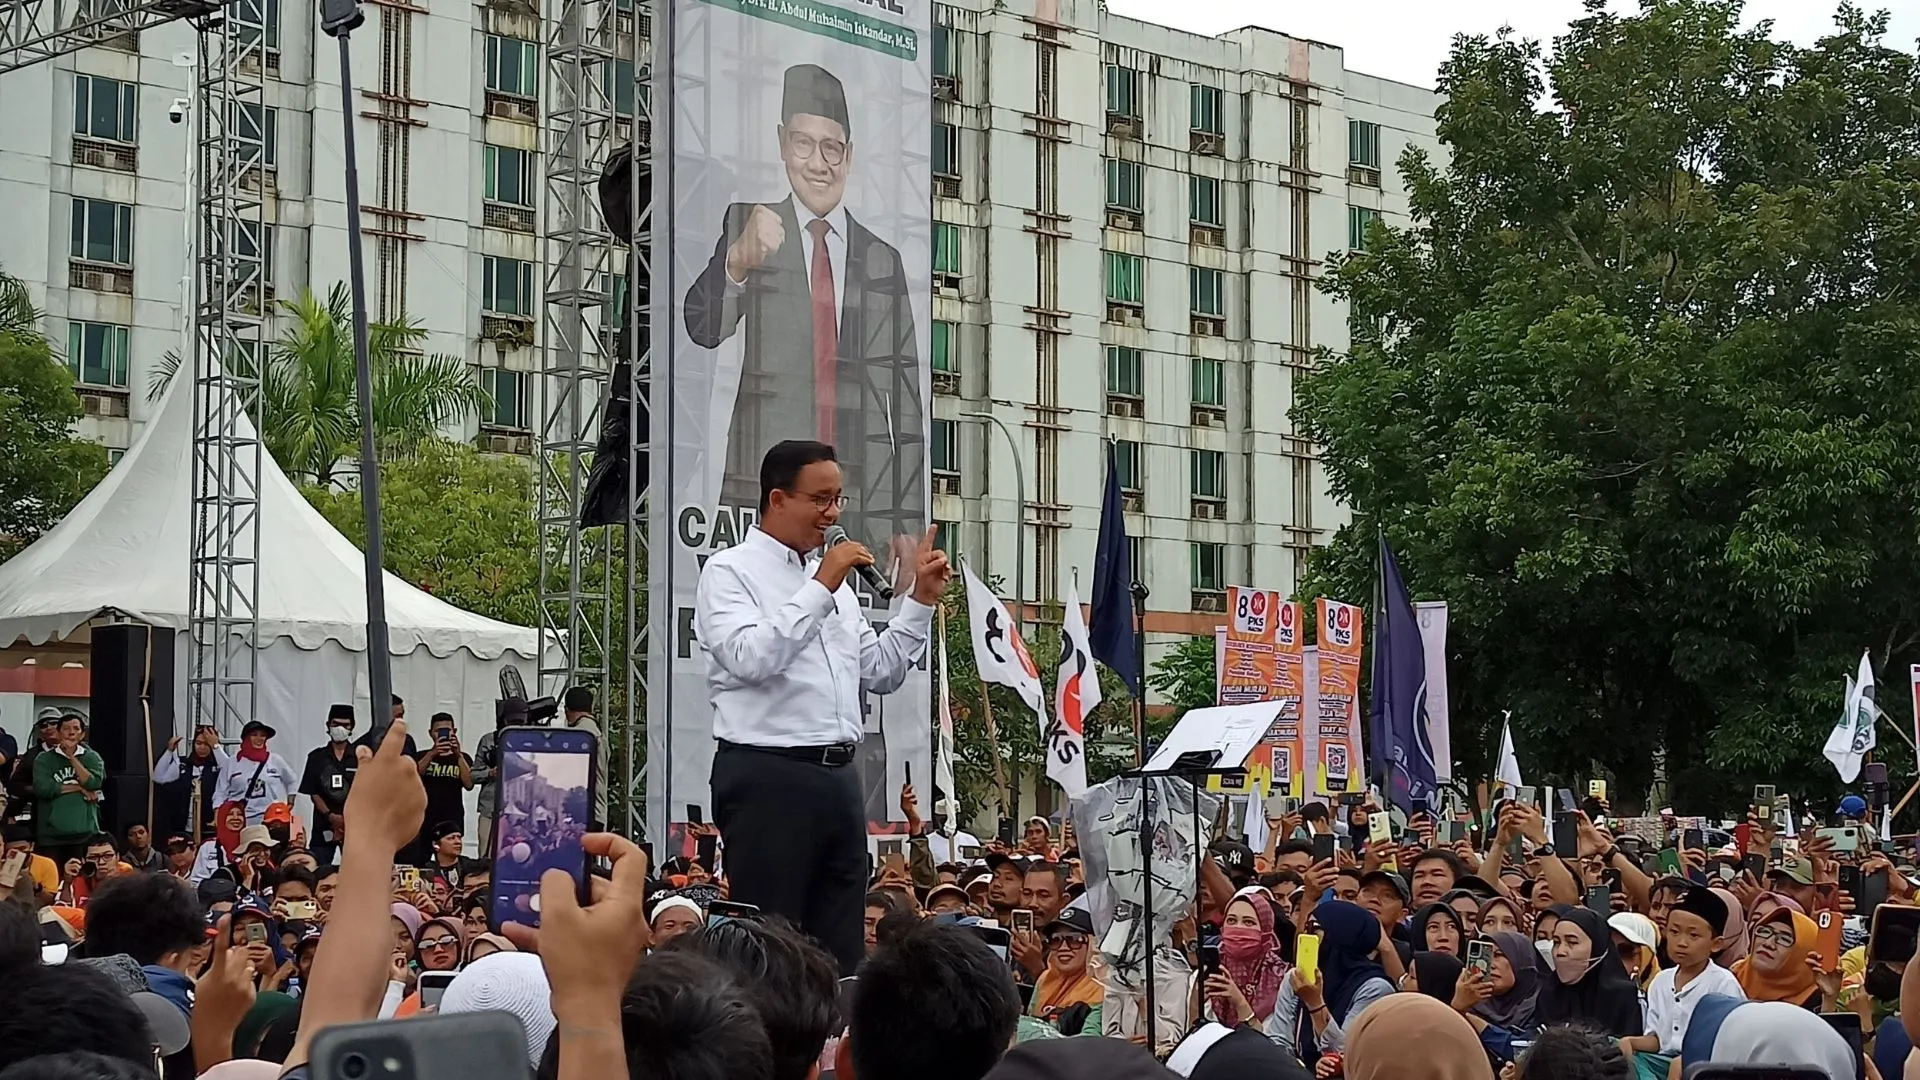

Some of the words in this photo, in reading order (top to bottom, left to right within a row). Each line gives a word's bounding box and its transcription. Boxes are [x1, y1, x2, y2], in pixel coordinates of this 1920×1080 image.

[780, 1, 808, 20] Abdul
[854, 21, 895, 47] Iskandar,
[1238, 595, 1249, 618] 8
[1247, 615, 1264, 627] PKS
[1328, 608, 1336, 630] 8
[1280, 627, 1293, 638] PKS
[1335, 628, 1351, 639] PKS
